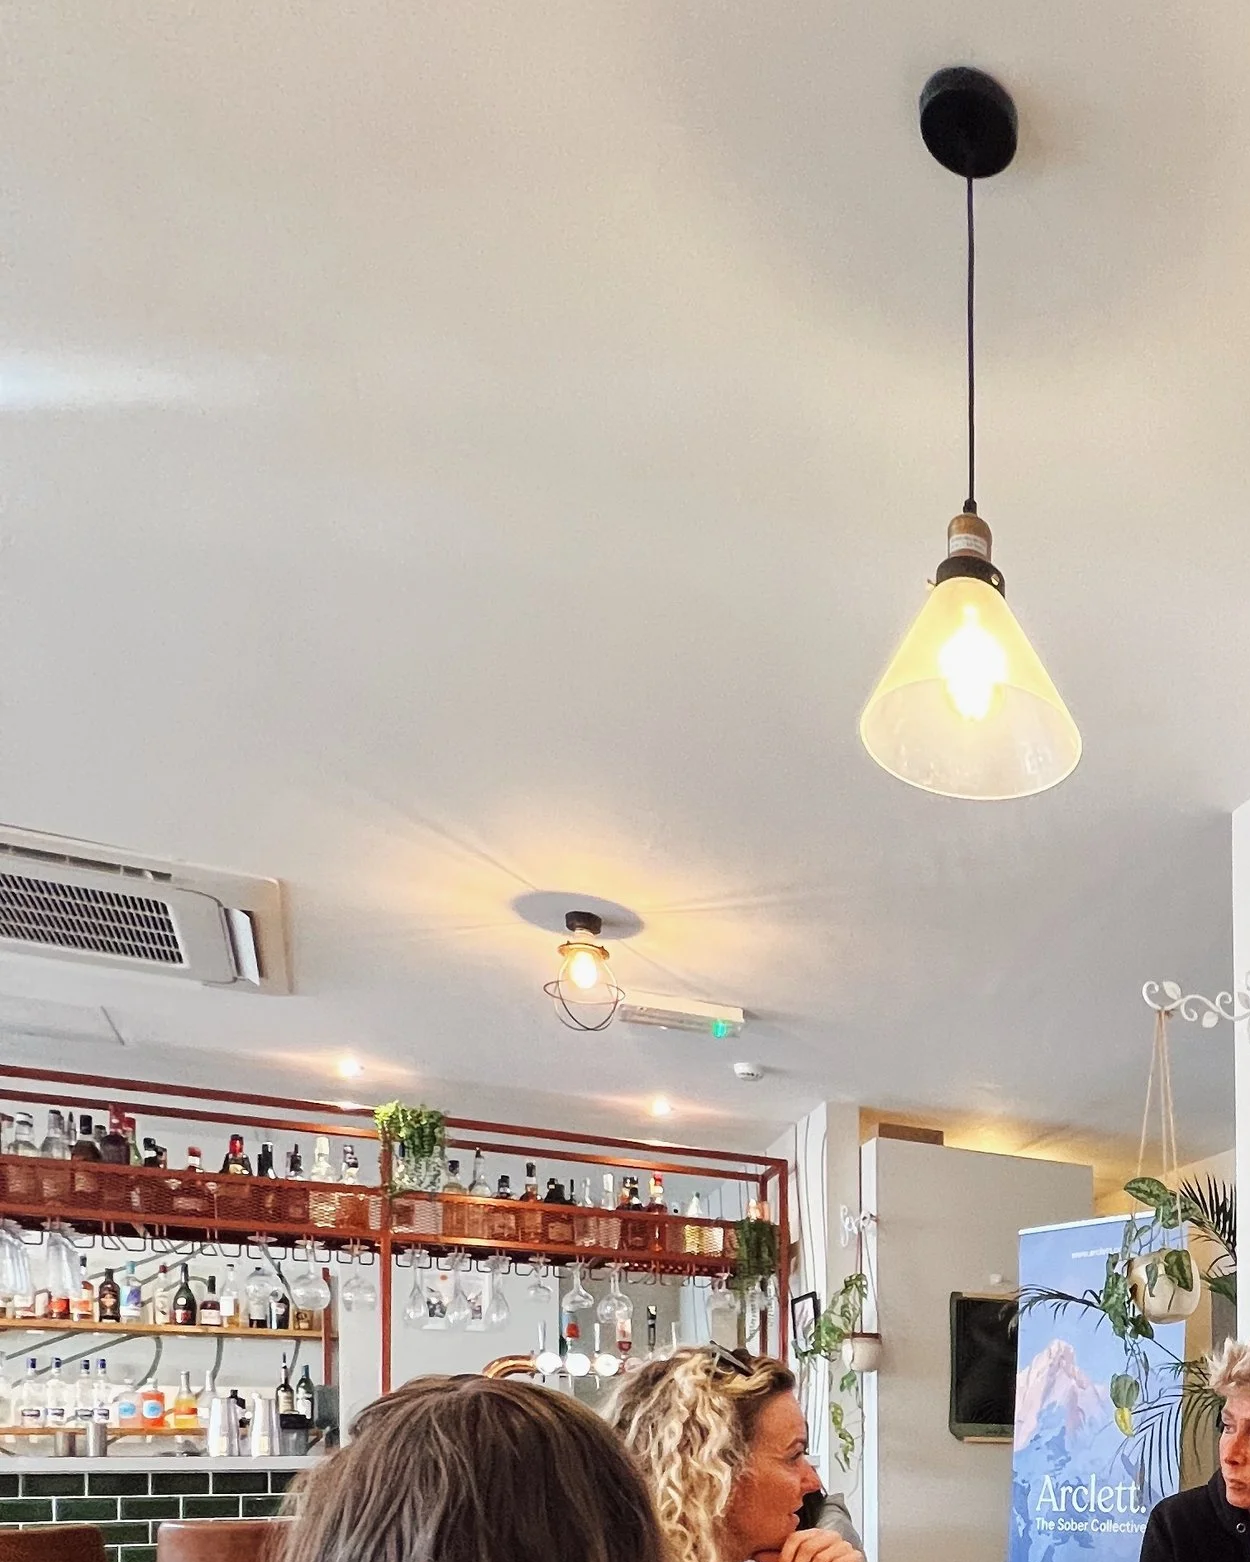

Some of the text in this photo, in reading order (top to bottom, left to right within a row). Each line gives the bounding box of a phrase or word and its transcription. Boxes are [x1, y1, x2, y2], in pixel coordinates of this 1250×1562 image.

[1035, 1473, 1147, 1514] Arclett.
[1035, 1517, 1147, 1534] The Sober Collective
